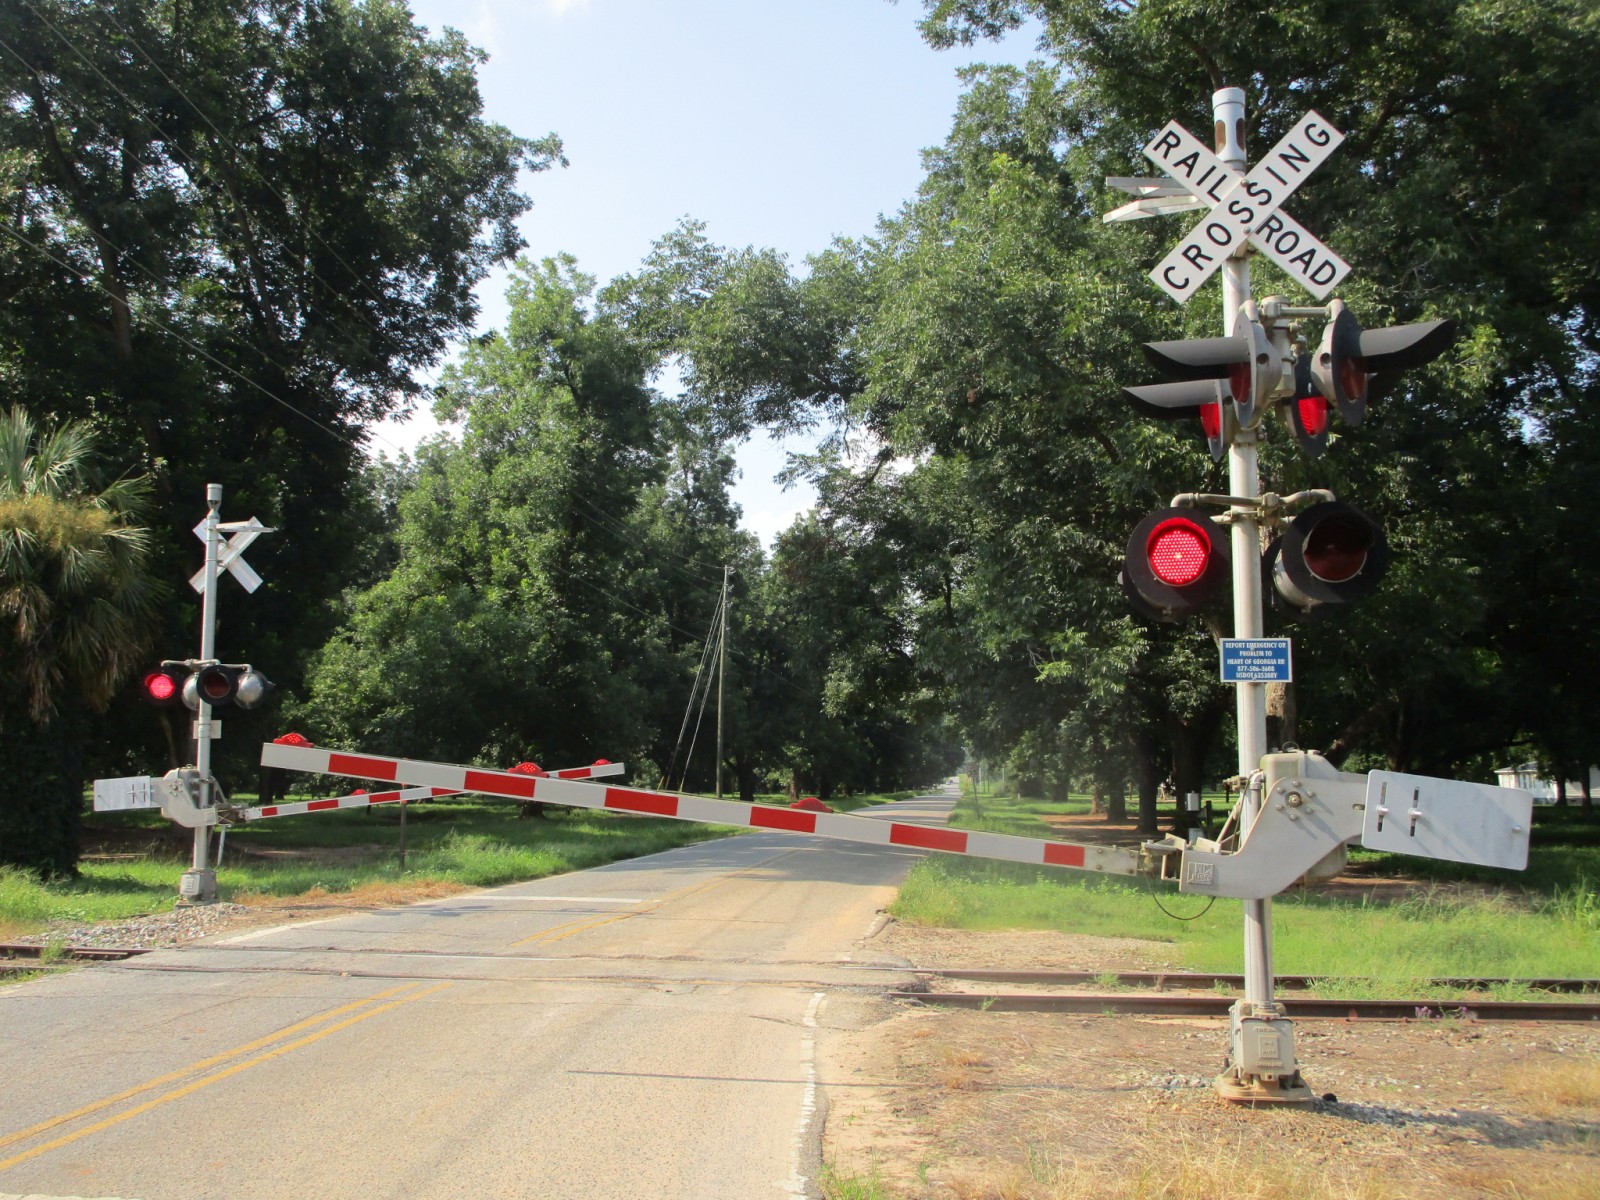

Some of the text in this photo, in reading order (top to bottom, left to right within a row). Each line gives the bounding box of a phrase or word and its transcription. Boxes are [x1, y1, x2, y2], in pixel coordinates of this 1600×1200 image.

[1153, 130, 1337, 286] RAIL ROAD
[1163, 123, 1330, 289] CROSSING
